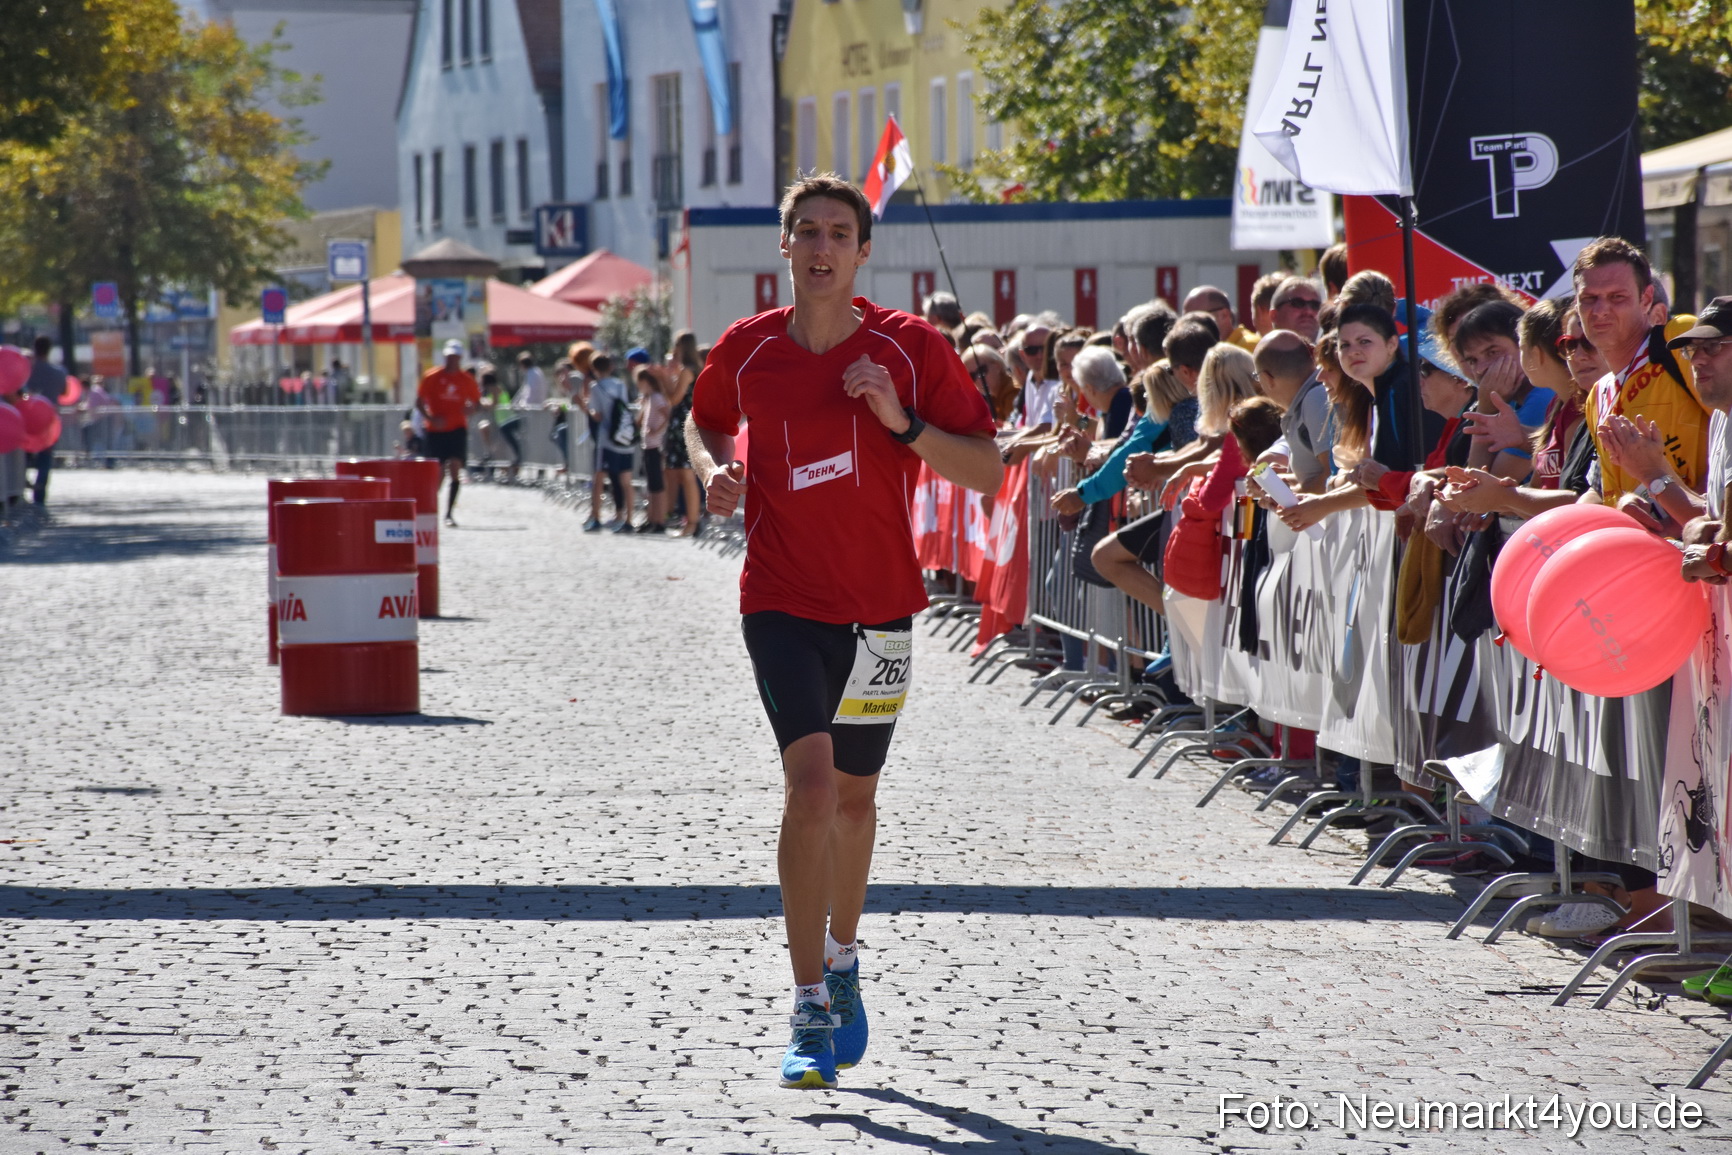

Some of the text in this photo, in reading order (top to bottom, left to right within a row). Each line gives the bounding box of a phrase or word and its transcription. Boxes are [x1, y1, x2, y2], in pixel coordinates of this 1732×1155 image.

[1477, 142, 1503, 152] Team
[808, 463, 836, 481] DEHN
[1574, 598, 1631, 672] RÖDL
[868, 655, 911, 686] 262
[861, 702, 898, 714] Markus
